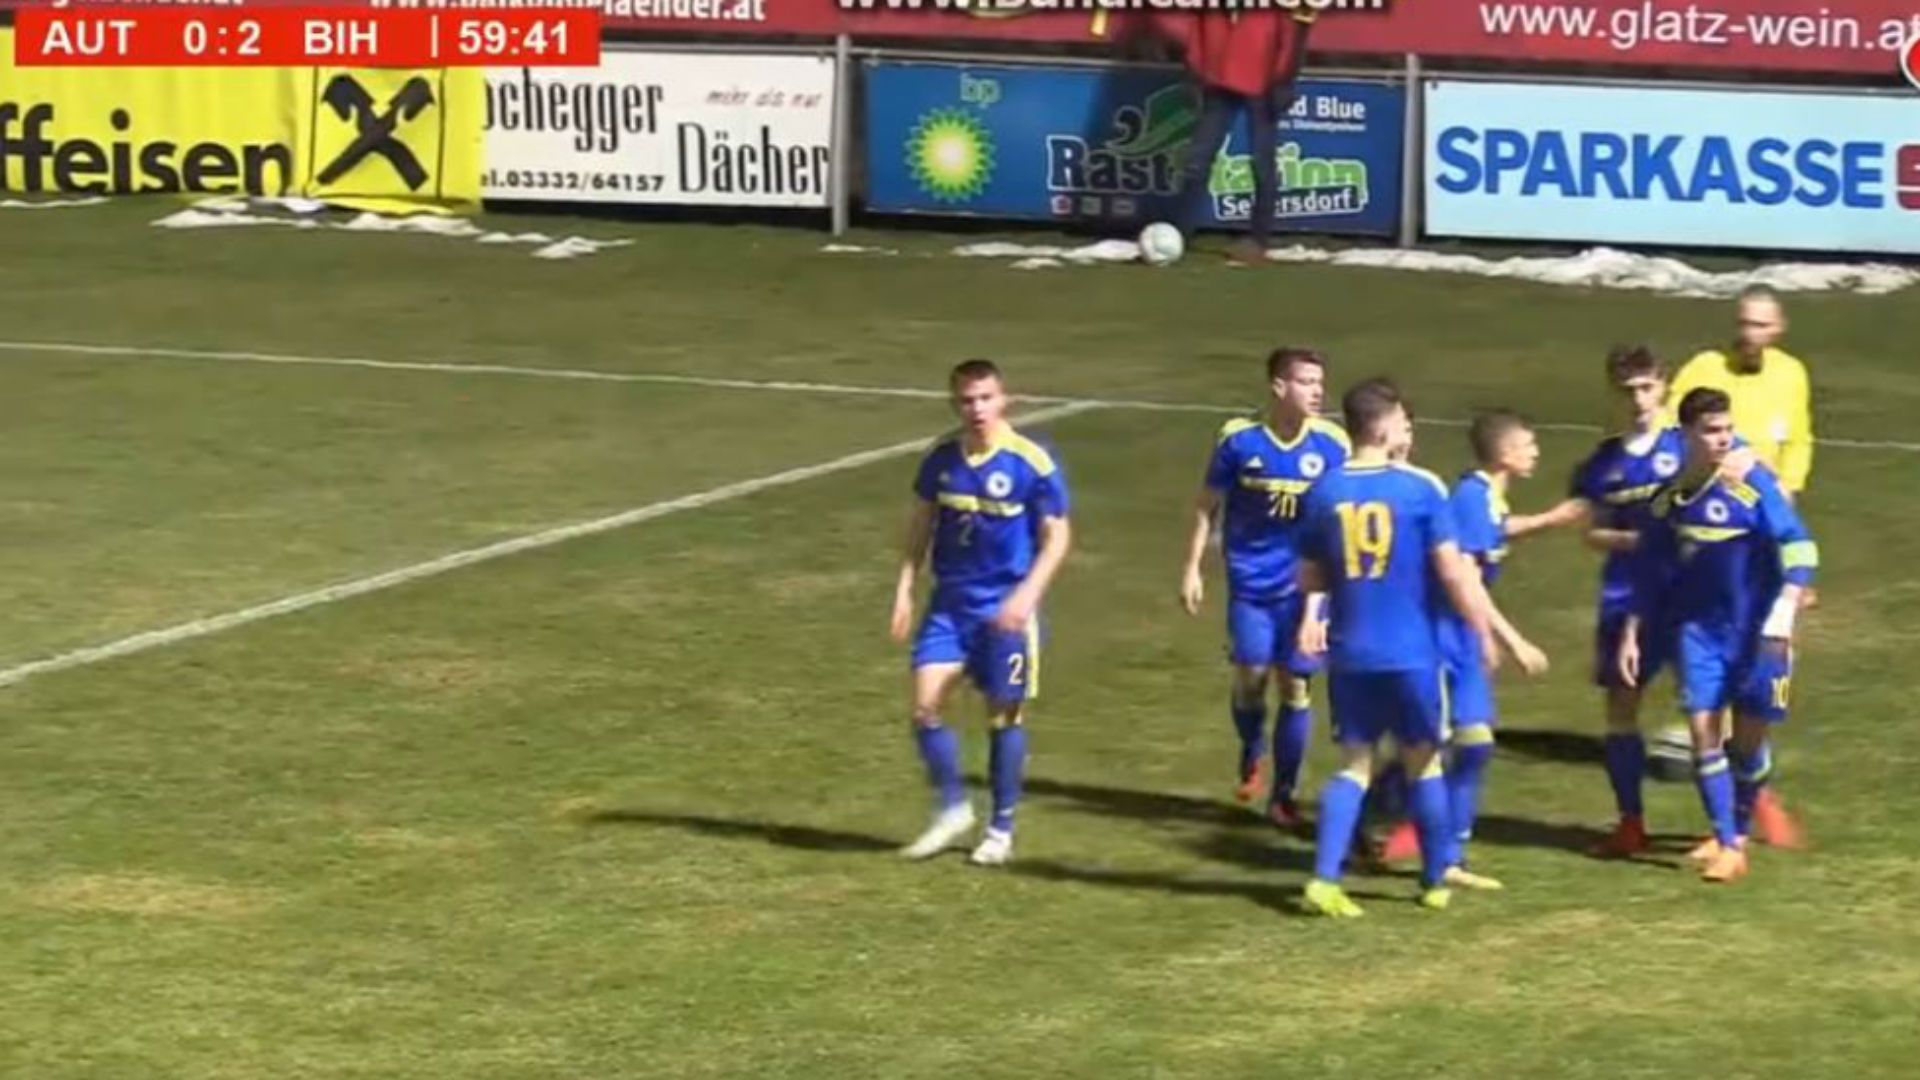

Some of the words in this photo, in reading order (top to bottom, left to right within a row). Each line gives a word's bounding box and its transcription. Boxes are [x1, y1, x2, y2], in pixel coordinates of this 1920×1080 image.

[960, 73, 999, 108] bp
[1316, 95, 1366, 119] Blue
[677, 122, 829, 195] Dächer
[1435, 126, 1885, 210] SPARKASSE
[1334, 501, 1394, 580] 19
[1007, 652, 1024, 685] 2
